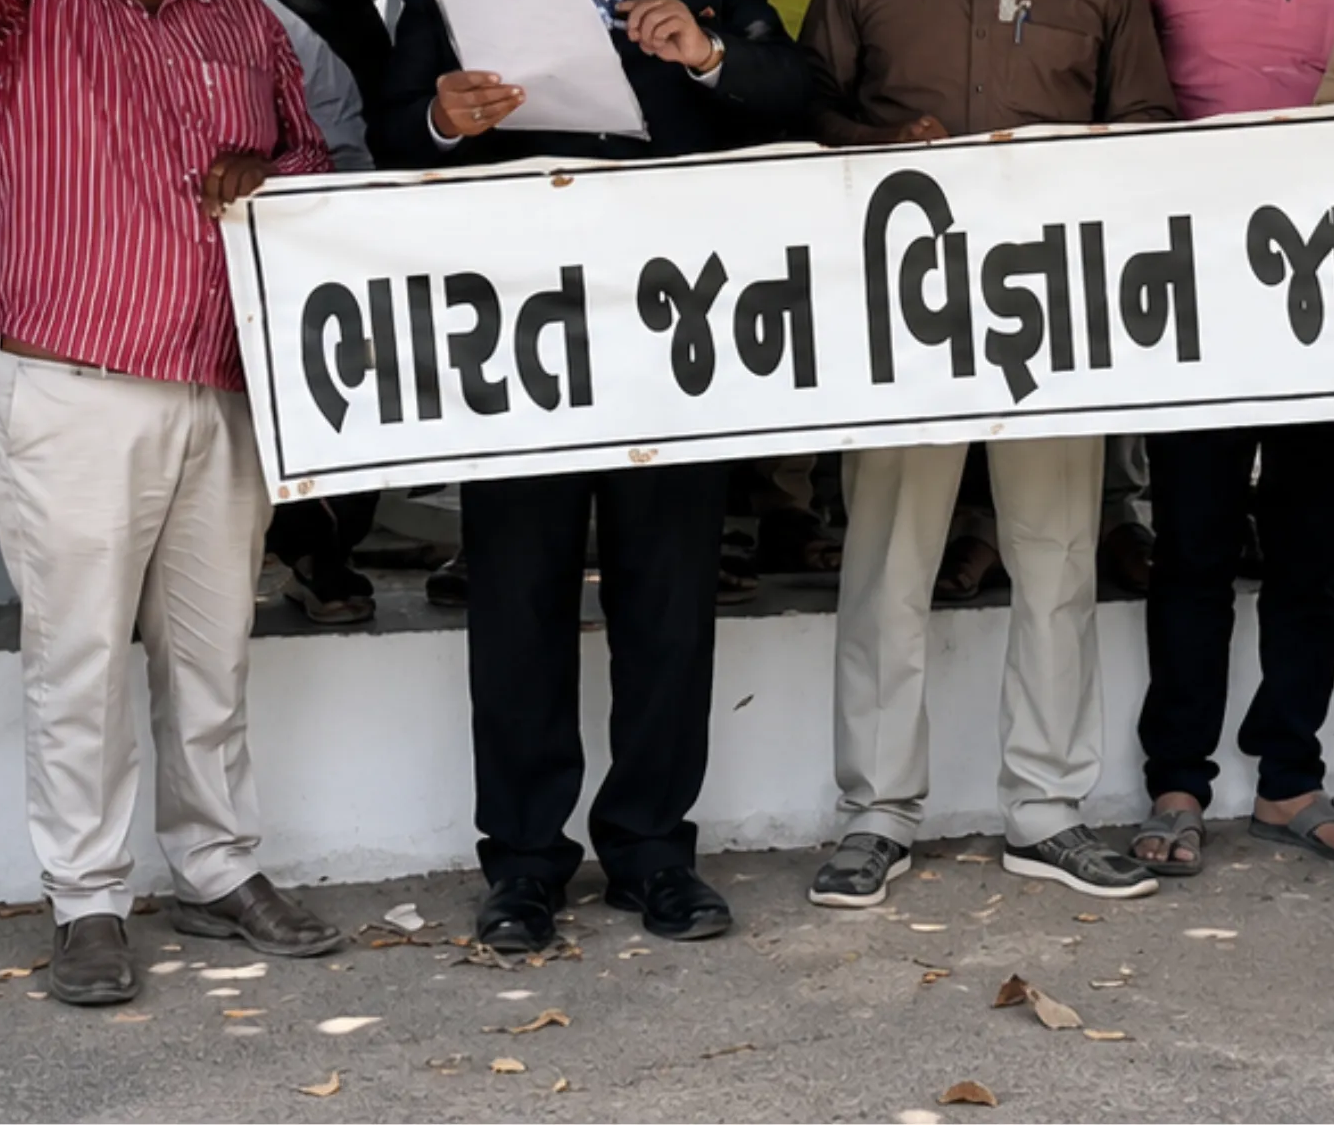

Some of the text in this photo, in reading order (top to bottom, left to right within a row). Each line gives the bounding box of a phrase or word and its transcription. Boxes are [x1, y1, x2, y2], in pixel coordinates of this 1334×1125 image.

[302, 266, 592, 433] ભારત
[637, 246, 817, 396] જન
[864, 171, 1200, 403] વિજ્ઞાન
